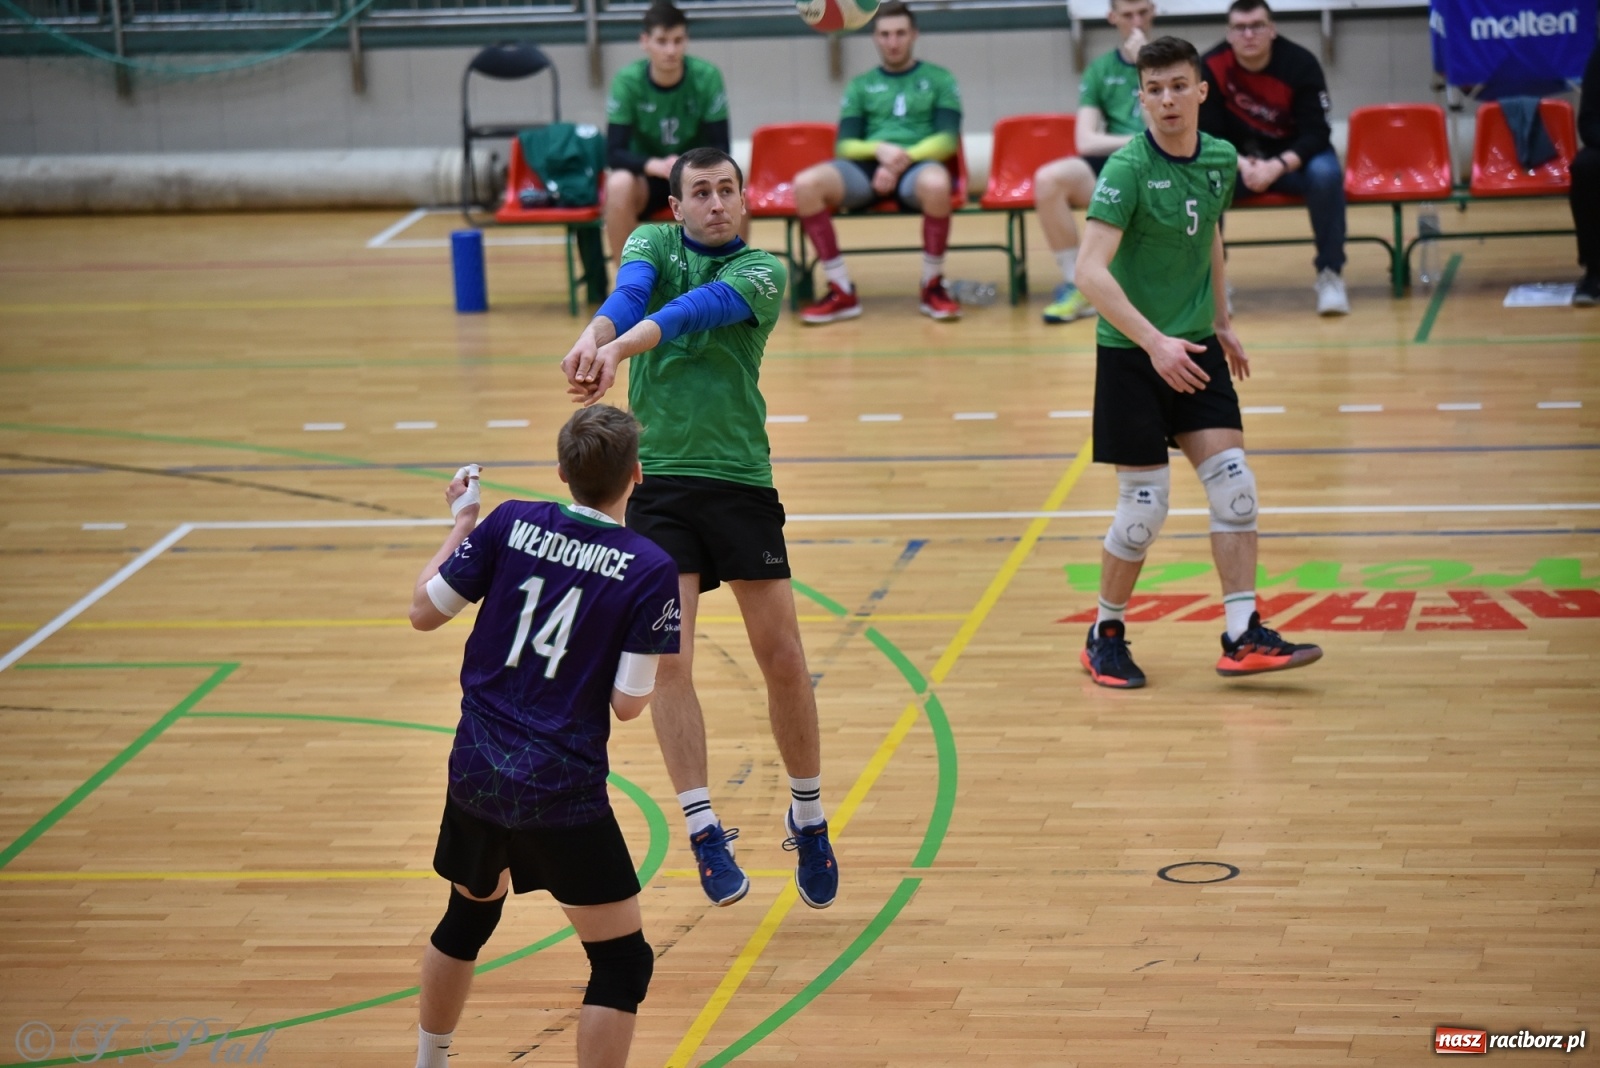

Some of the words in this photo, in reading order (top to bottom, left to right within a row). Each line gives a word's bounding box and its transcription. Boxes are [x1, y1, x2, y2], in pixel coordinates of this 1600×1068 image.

[1470, 10, 1577, 40] molten
[659, 118, 680, 145] 12
[1185, 200, 1199, 236] 5
[504, 575, 583, 679] 14
